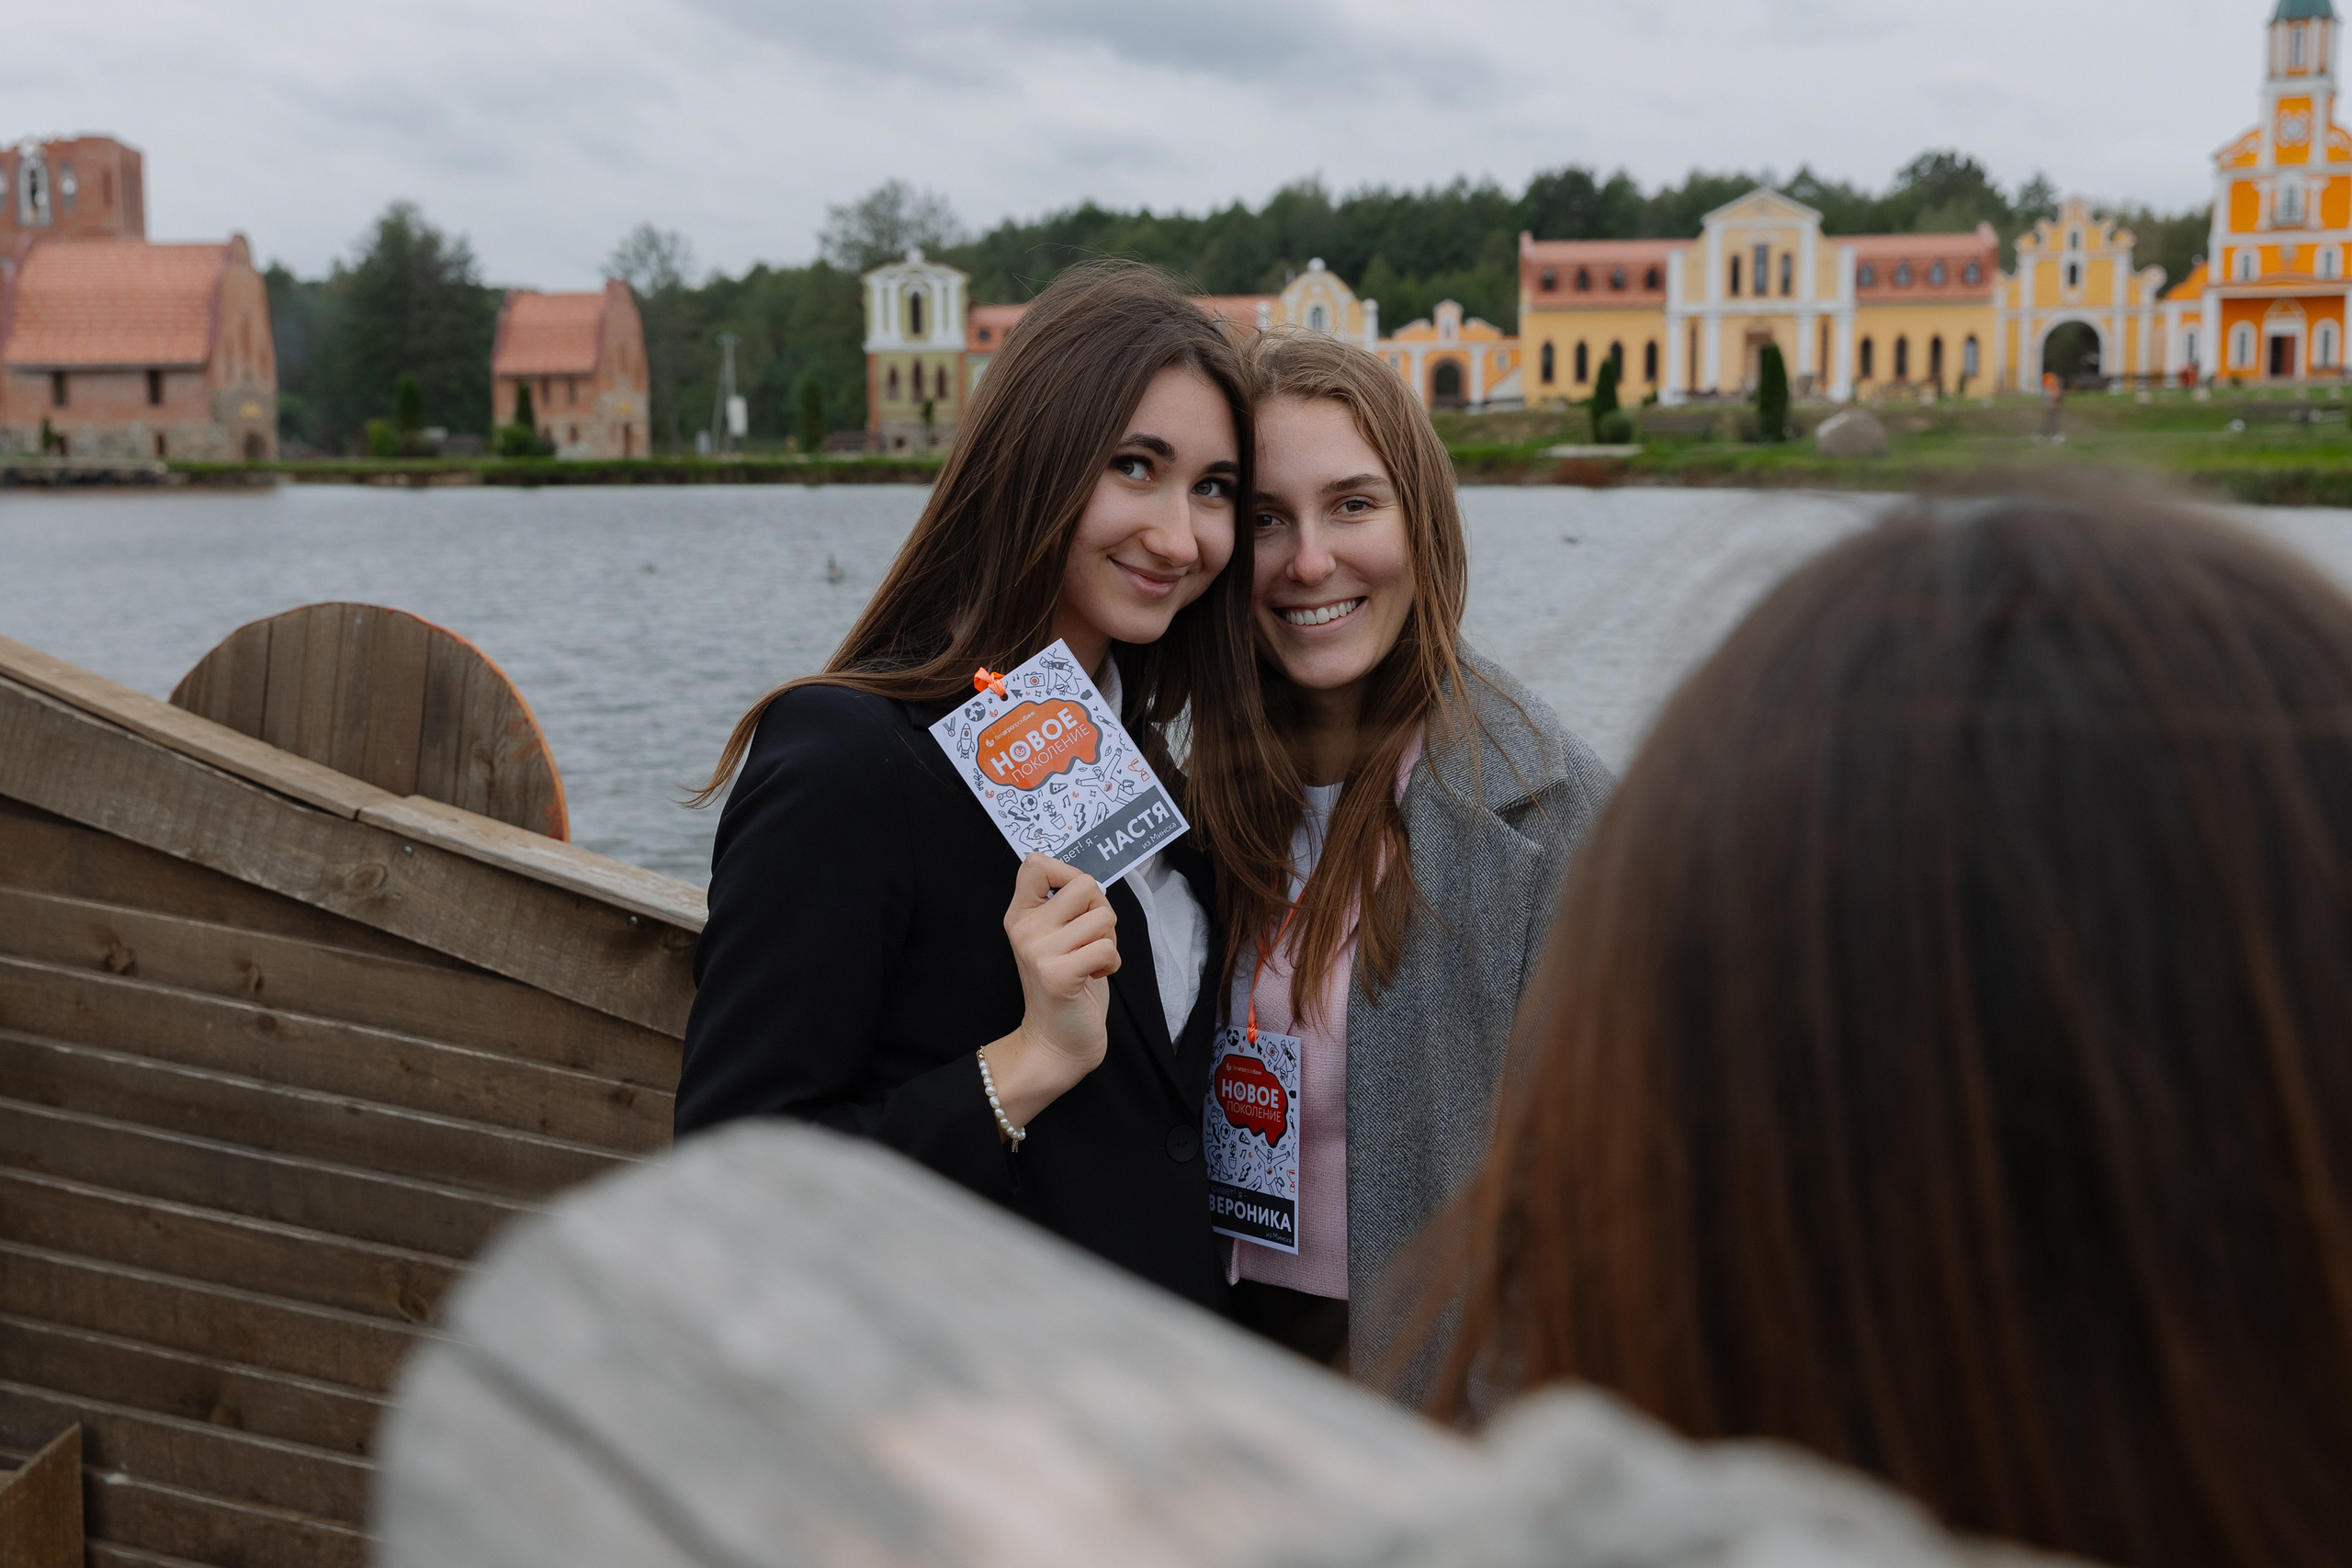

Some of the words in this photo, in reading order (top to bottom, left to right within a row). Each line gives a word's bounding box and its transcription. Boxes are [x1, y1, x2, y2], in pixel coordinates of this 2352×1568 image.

[990, 707, 1079, 776] НОВОЕ
[1012, 724, 1090, 782] ПОКОЛЕНИЕ
[1085, 838, 1093, 848] я
[1096, 800, 1170, 861] НАСТЯ
[1141, 840, 1151, 850] из
[1149, 821, 1177, 842] Минска
[1221, 1078, 1279, 1109] НОВОЕ
[1227, 1100, 1282, 1122] ПОКОЛЕНИЕ
[1208, 1193, 1292, 1233] ВЕРОНИКА
